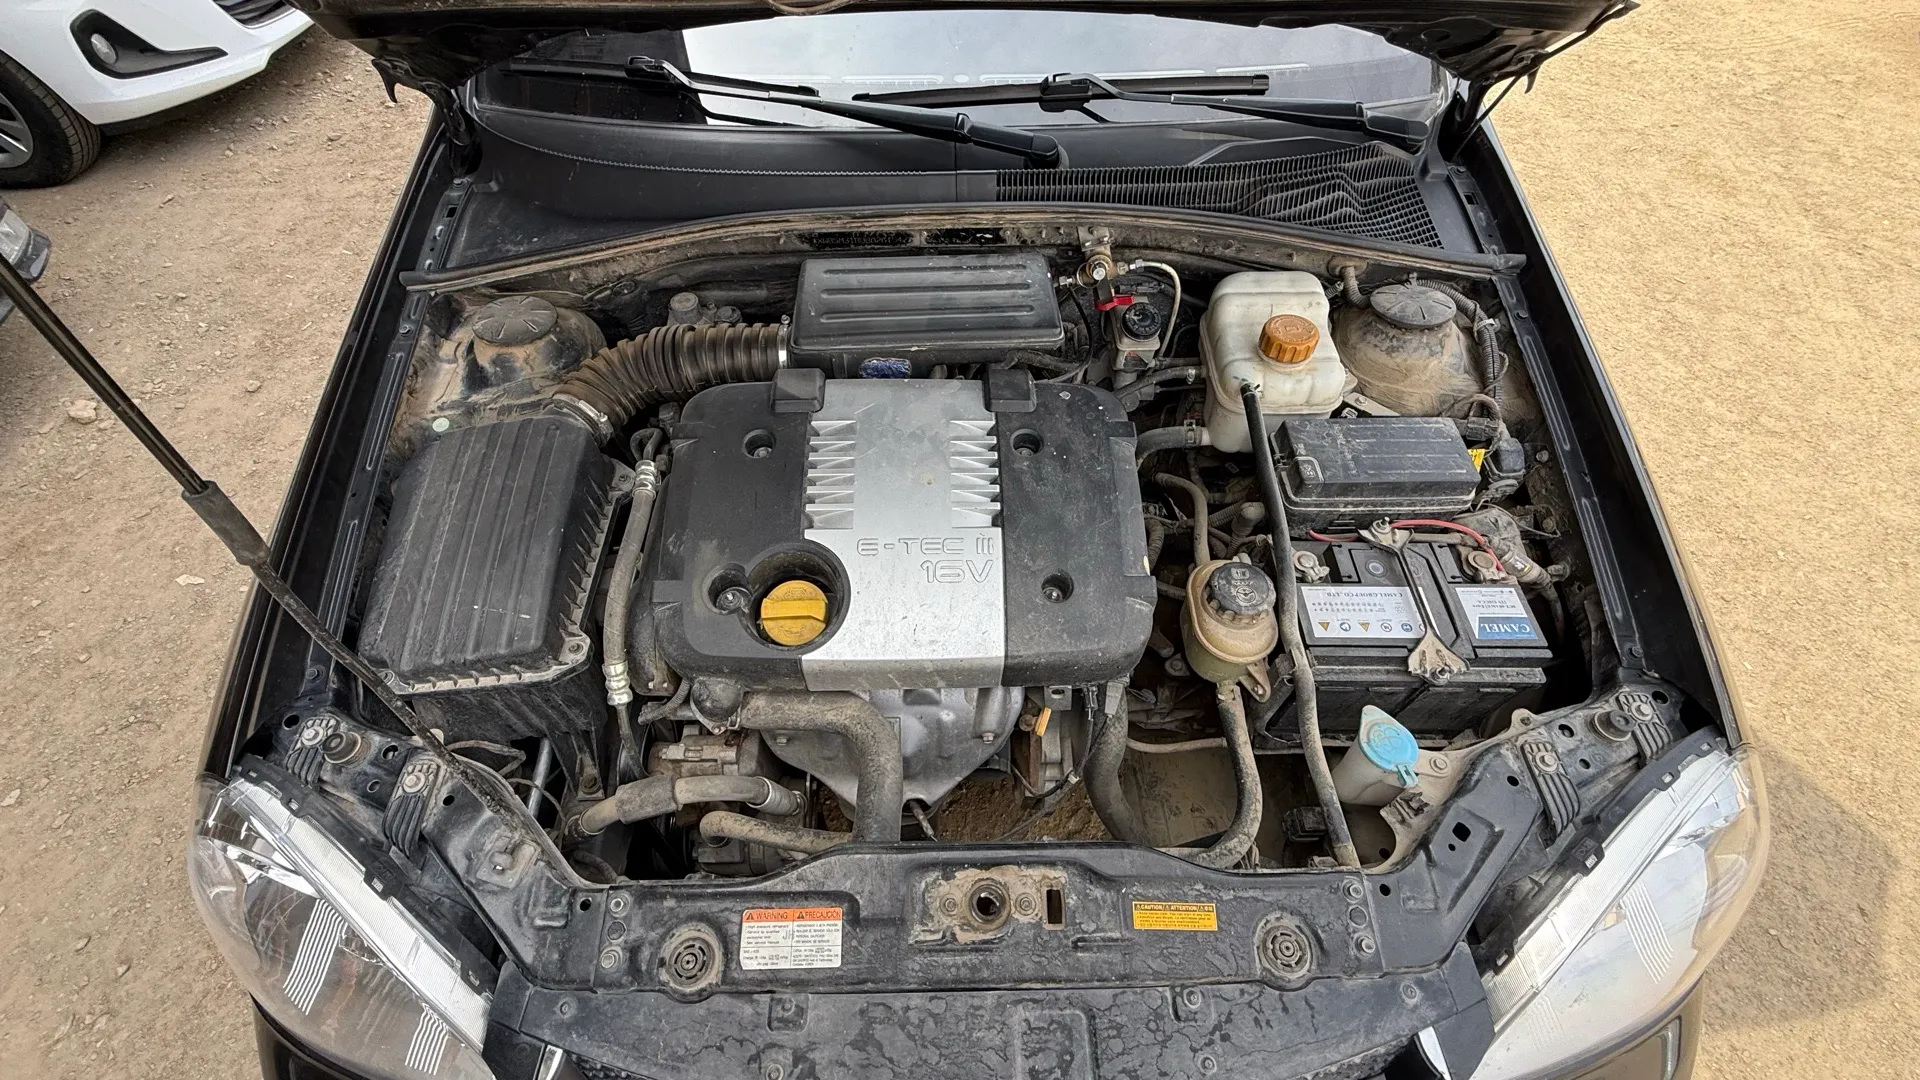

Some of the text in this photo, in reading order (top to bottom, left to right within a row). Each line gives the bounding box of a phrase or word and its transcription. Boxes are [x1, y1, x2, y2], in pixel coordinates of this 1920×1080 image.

[920, 559, 994, 583] 16V
[1481, 623, 1530, 633] CAMEL
[756, 912, 788, 920] WARNING
[805, 910, 840, 919] PRECAUCIÓN
